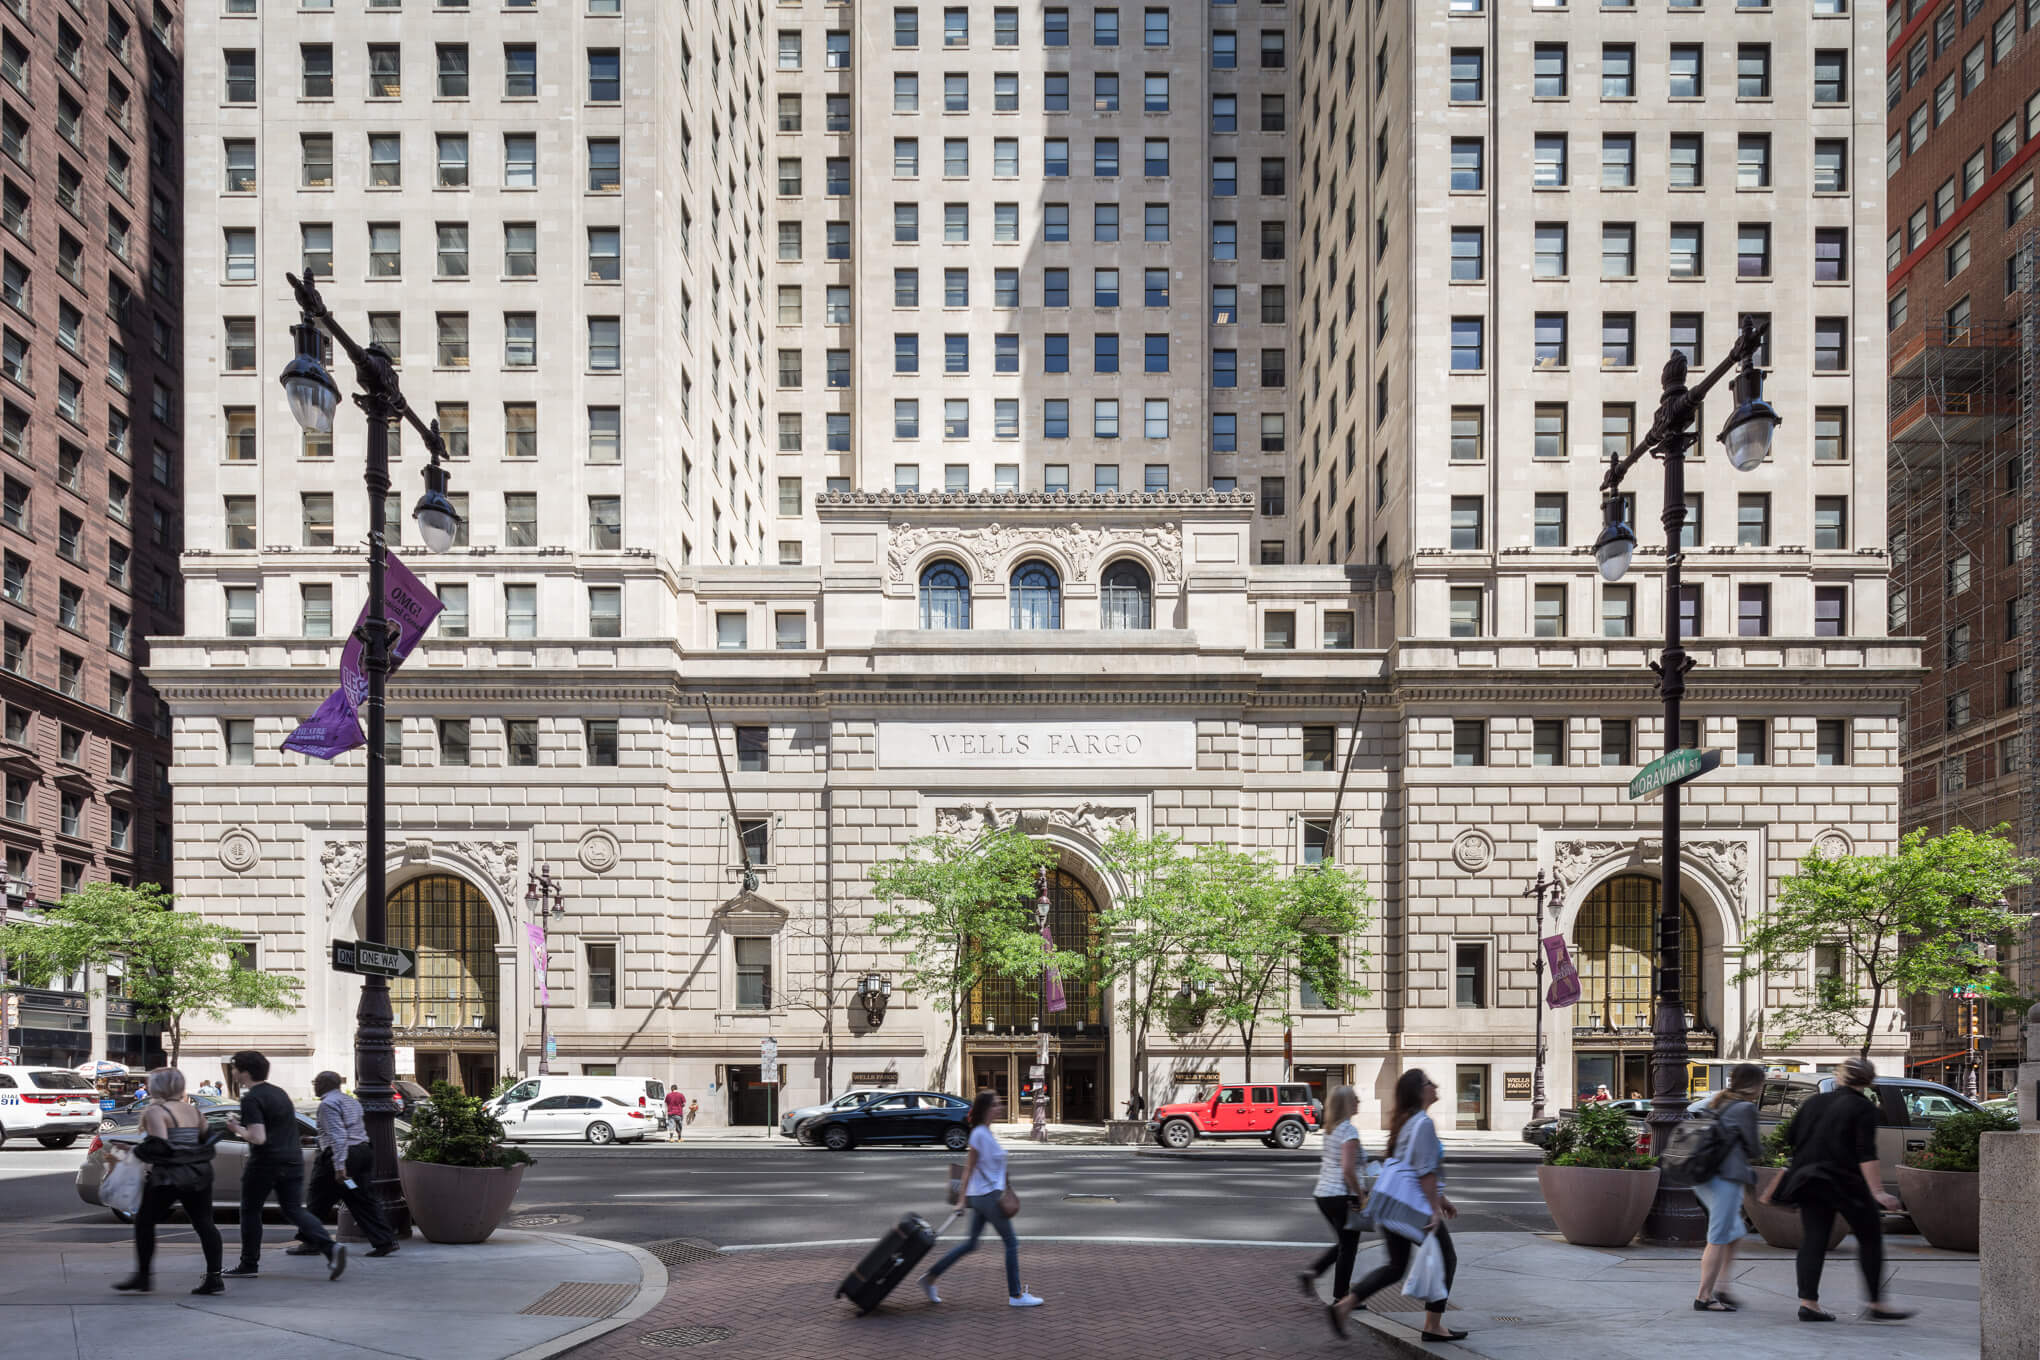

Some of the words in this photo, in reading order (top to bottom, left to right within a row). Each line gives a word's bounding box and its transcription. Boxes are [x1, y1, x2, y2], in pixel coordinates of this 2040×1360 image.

[391, 587, 423, 618] OMG!
[930, 734, 1030, 754] WELLS
[1047, 734, 1142, 754] FARGO
[1631, 758, 1686, 797] MORAVIAN
[1689, 758, 1699, 771] ST
[340, 950, 354, 963] ON
[362, 951, 379, 964] ONE
[381, 952, 398, 967] WAY
